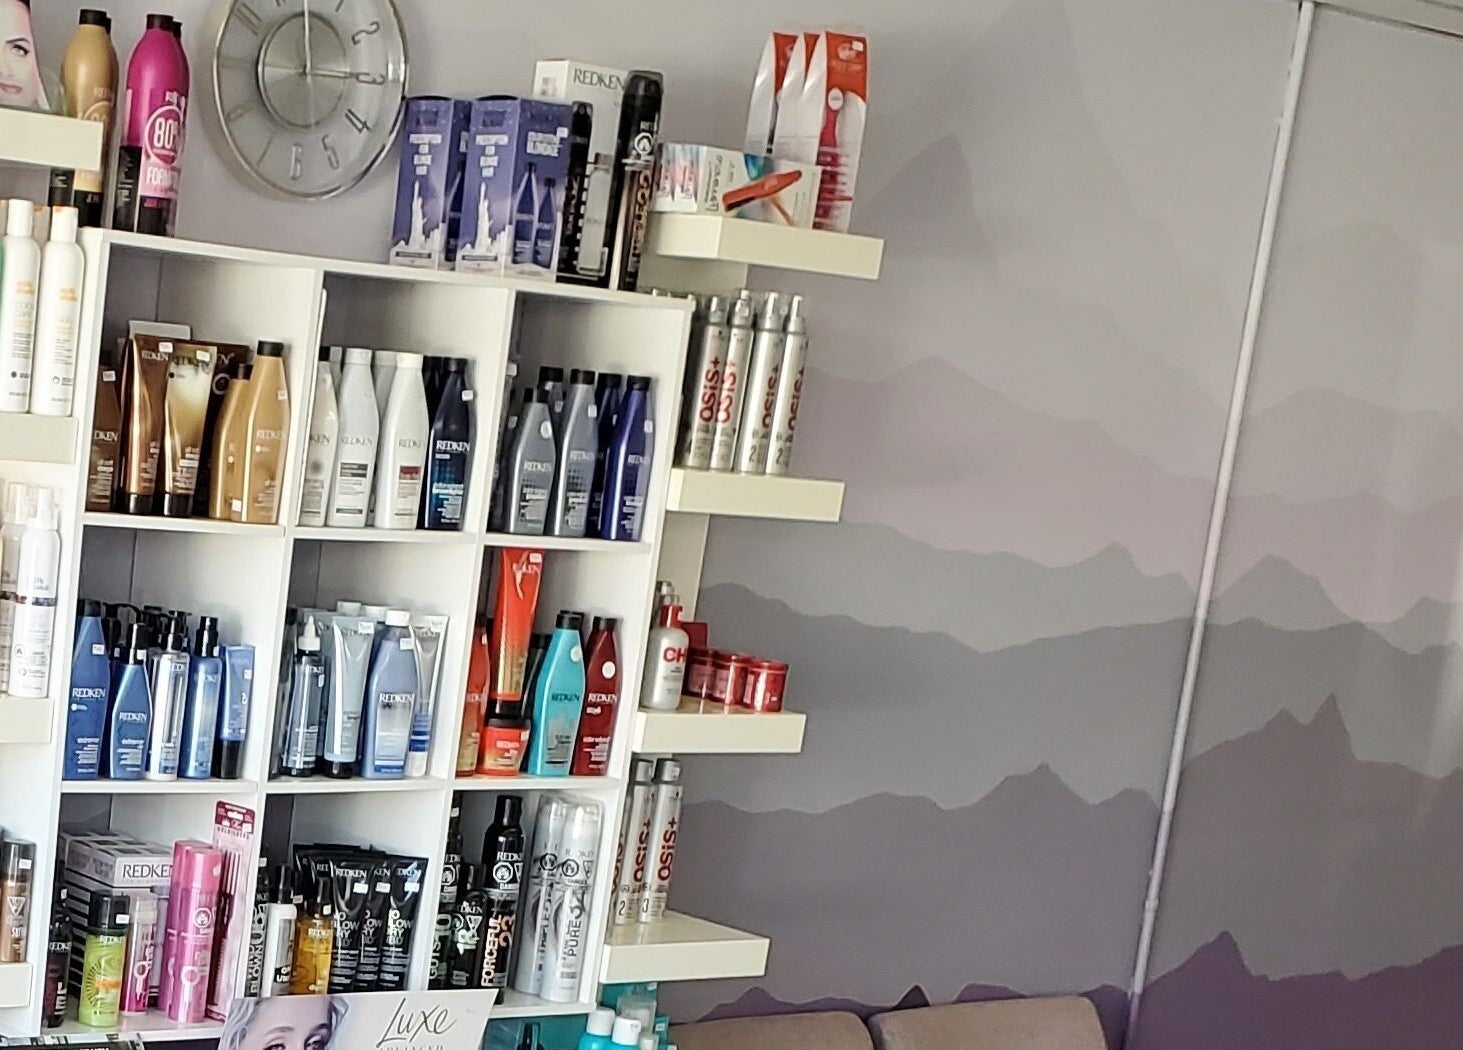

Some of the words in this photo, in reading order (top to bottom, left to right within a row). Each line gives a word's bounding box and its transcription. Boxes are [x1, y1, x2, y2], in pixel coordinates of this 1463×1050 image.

[344, 108, 372, 135] 4
[322, 134, 340, 170] 5
[436, 439, 471, 452] REDKEN
[72, 687, 106, 699] REDKEN
[119, 711, 147, 722] REDKEN
[480, 914, 503, 987] FORCEFUL
[567, 920, 583, 957] PURE
[375, 997, 457, 1048] Luxe
